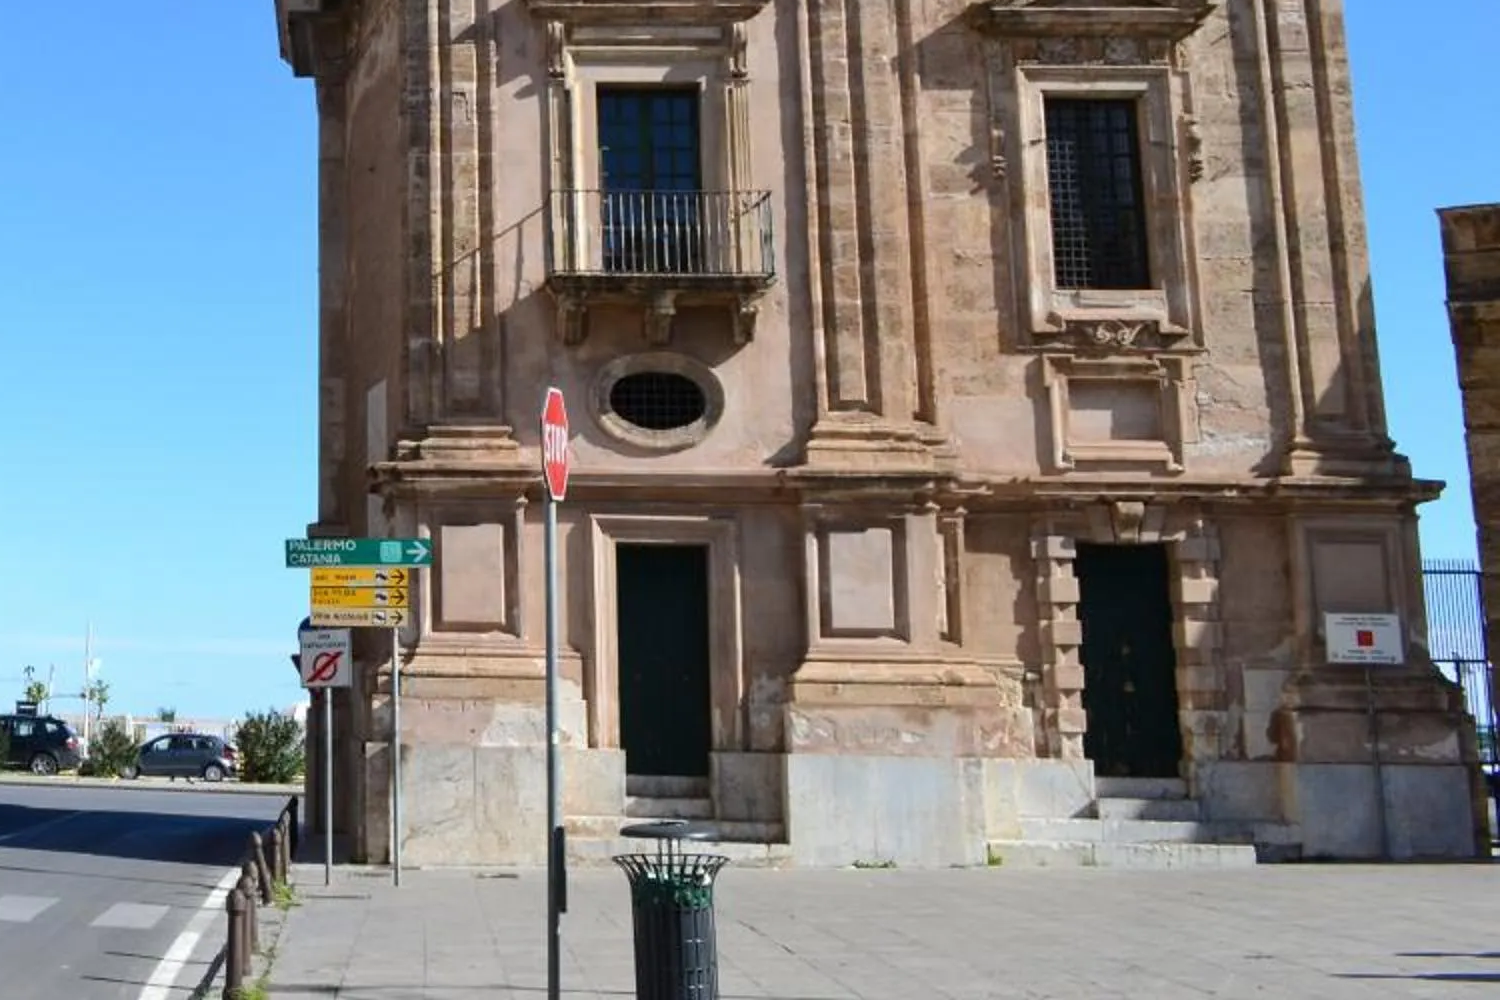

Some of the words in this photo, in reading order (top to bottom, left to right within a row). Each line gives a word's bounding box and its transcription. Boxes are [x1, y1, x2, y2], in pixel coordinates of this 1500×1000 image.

[545, 423, 567, 464] STOP
[289, 539, 357, 551] PALERMO
[289, 553, 341, 565] CATANIA
